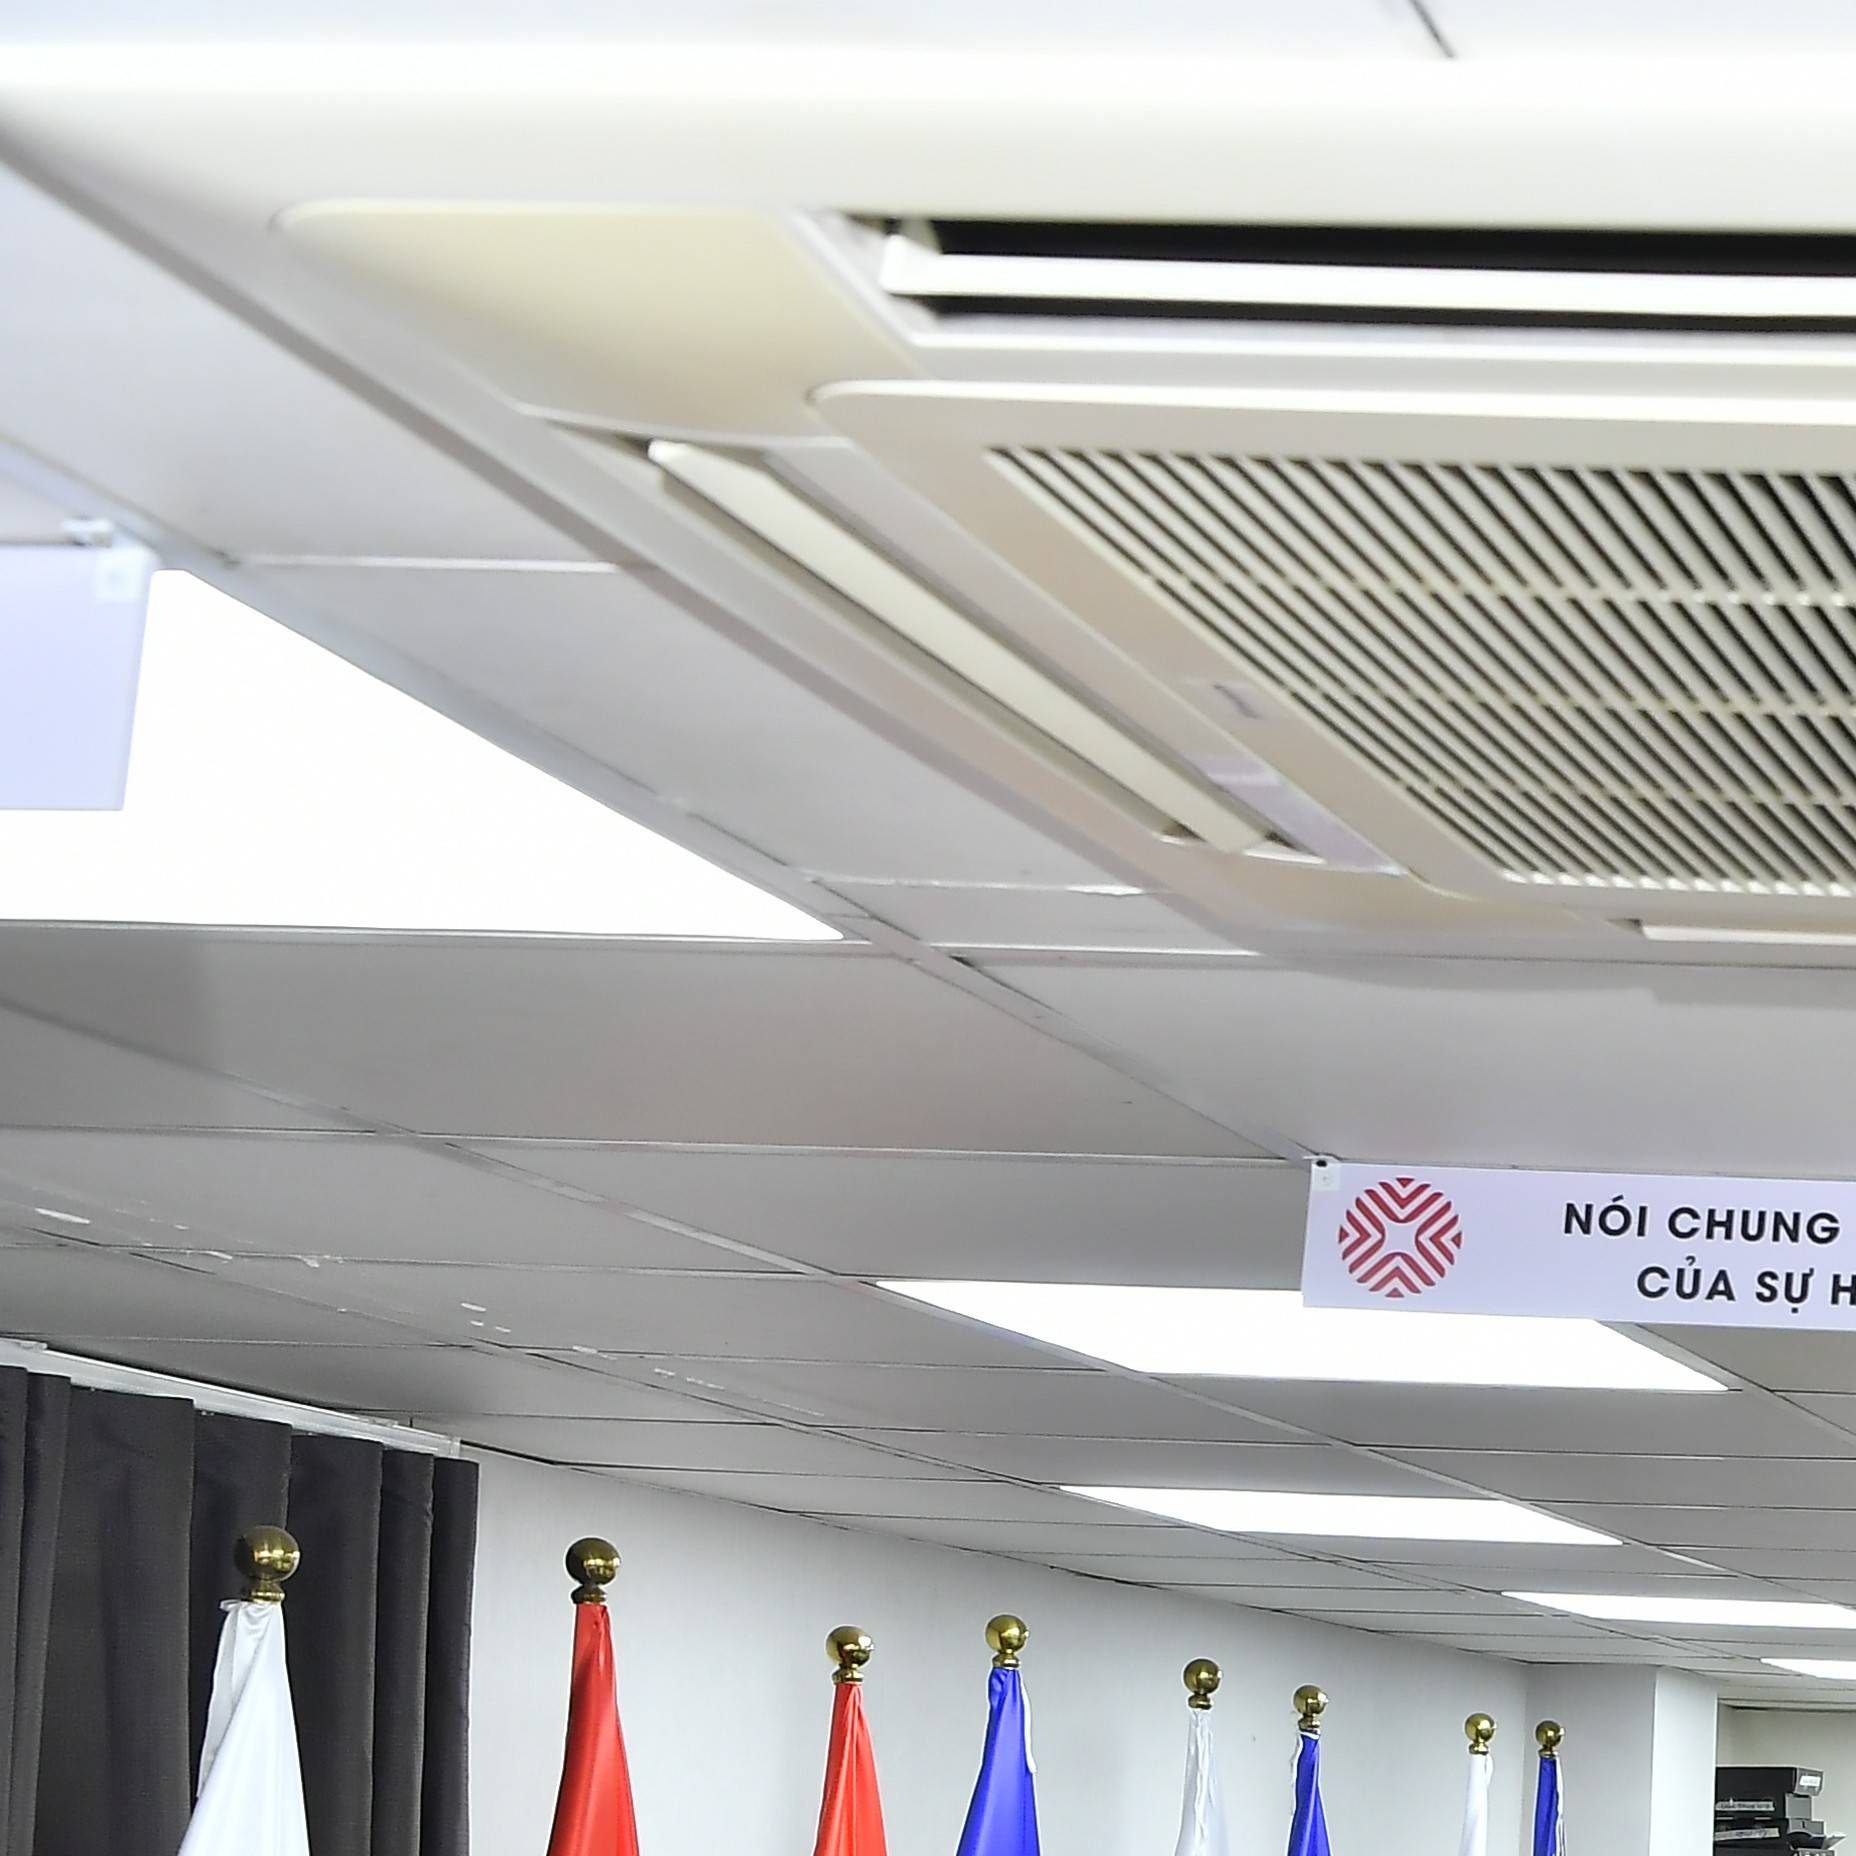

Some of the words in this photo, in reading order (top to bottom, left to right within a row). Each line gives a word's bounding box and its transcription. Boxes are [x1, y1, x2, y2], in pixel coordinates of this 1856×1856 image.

[1563, 1196, 1647, 1240] NÓI
[1667, 1205, 1841, 1246] CHUNG
[1636, 1257, 1736, 1302] CỦA
[1755, 1270, 1813, 1316] SỰ
